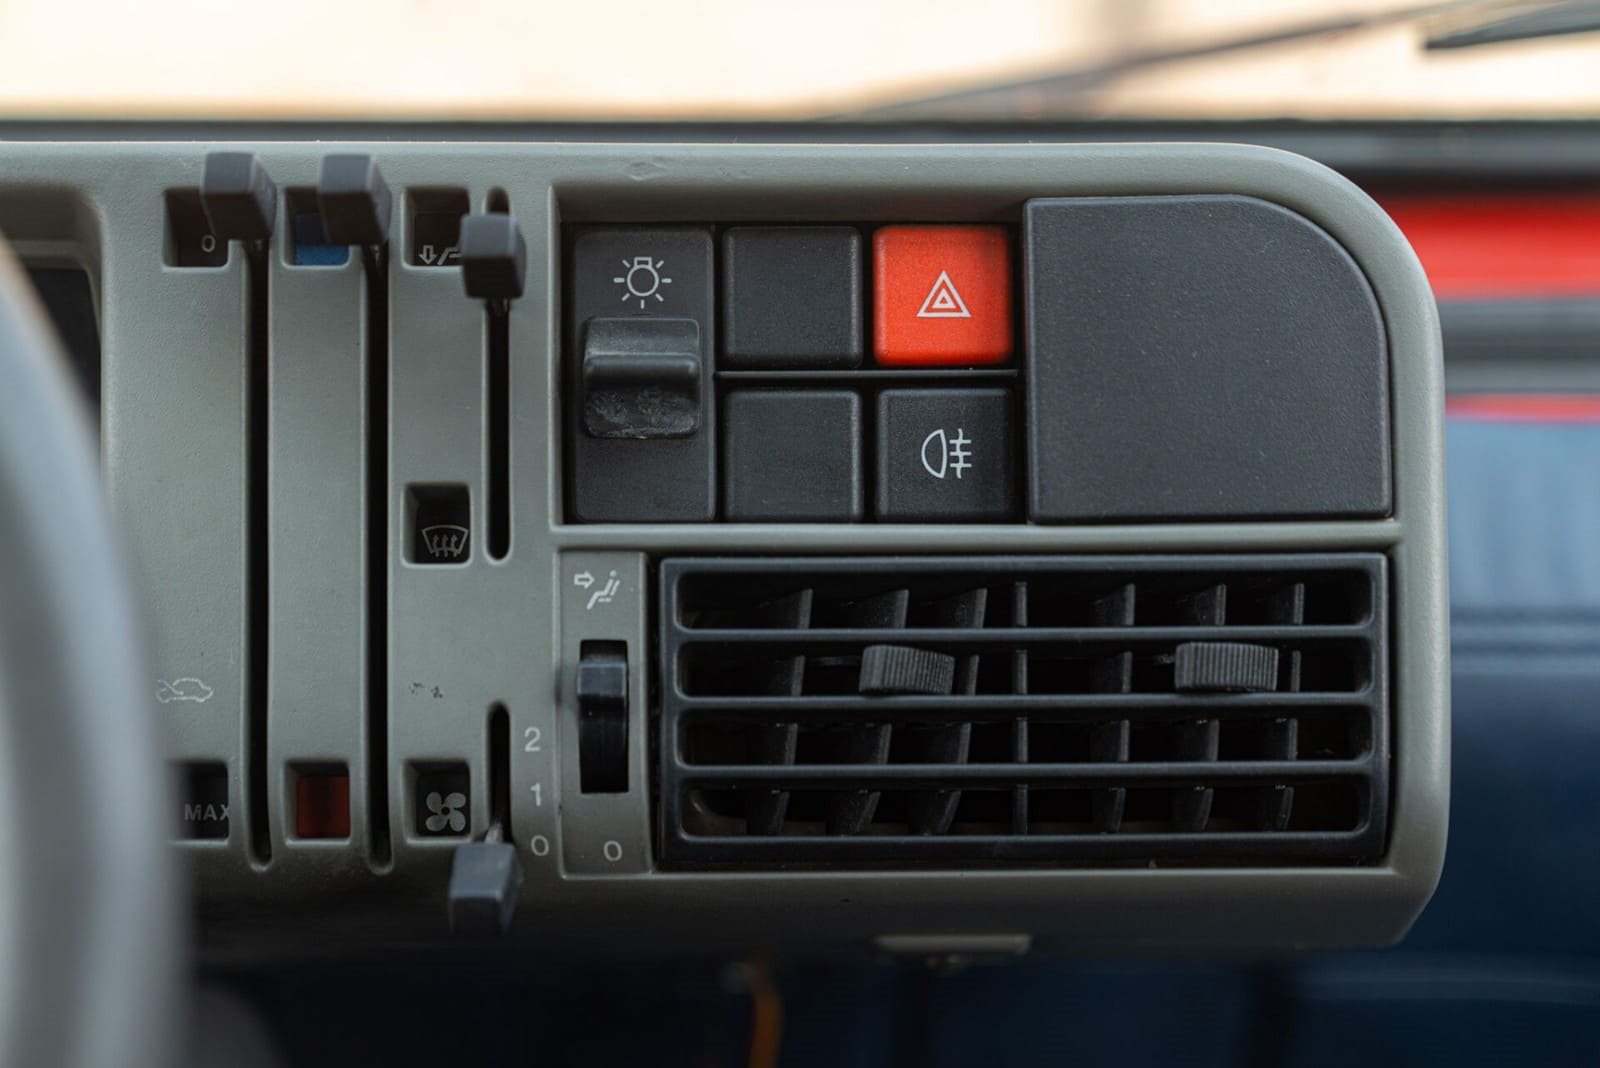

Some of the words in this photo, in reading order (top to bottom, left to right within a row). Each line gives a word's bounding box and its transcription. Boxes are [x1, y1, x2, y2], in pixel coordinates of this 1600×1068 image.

[202, 234, 215, 253] 0
[524, 726, 541, 752] 2
[530, 783, 541, 806] 1
[184, 803, 230, 821] MAX
[530, 835, 549, 856] 0
[603, 840, 622, 861] 0
